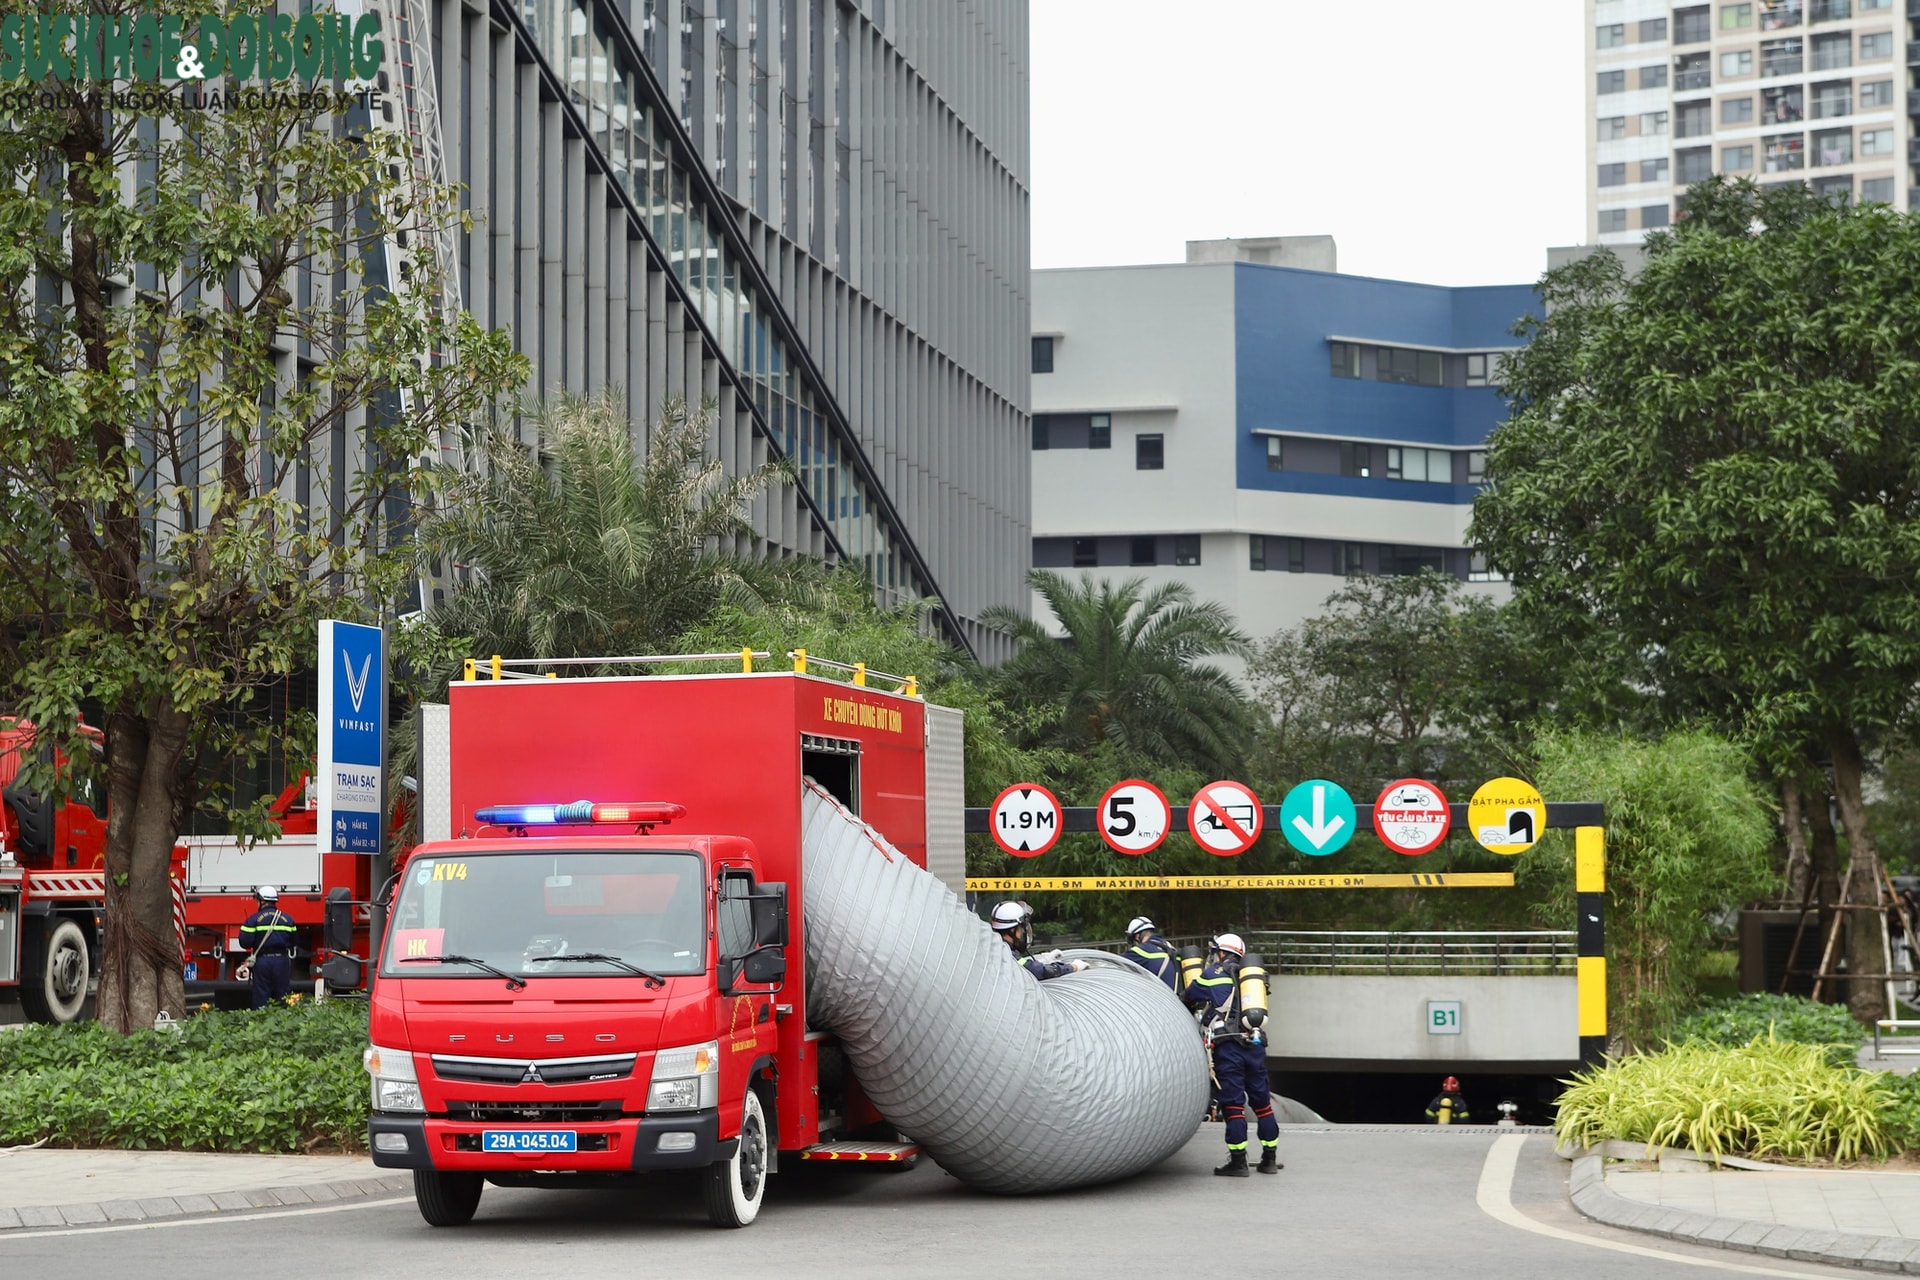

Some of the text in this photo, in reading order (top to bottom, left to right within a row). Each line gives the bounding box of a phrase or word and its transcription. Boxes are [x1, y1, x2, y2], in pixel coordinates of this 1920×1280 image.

[823, 696, 833, 721] XE
[339, 718, 375, 733] VINFAST
[336, 773, 376, 791] TRẠM SẠC
[999, 811, 1054, 829] 1.9M
[1108, 797, 1136, 837] 5
[1377, 811, 1396, 822] YÊU
[1434, 814, 1447, 823] XE
[1138, 829, 1161, 839] km/h
[432, 863, 467, 881] KV4
[1023, 881, 1041, 889] ĐA
[1048, 880, 1082, 889] 1.9M
[1096, 880, 1170, 889] MAXIMUM
[1176, 879, 1231, 888] HEIGHT
[407, 938, 428, 957] HK
[1433, 1011, 1456, 1026] B1
[449, 1034, 616, 1043] FUSO
[490, 1134, 569, 1148] 29A-045.04
